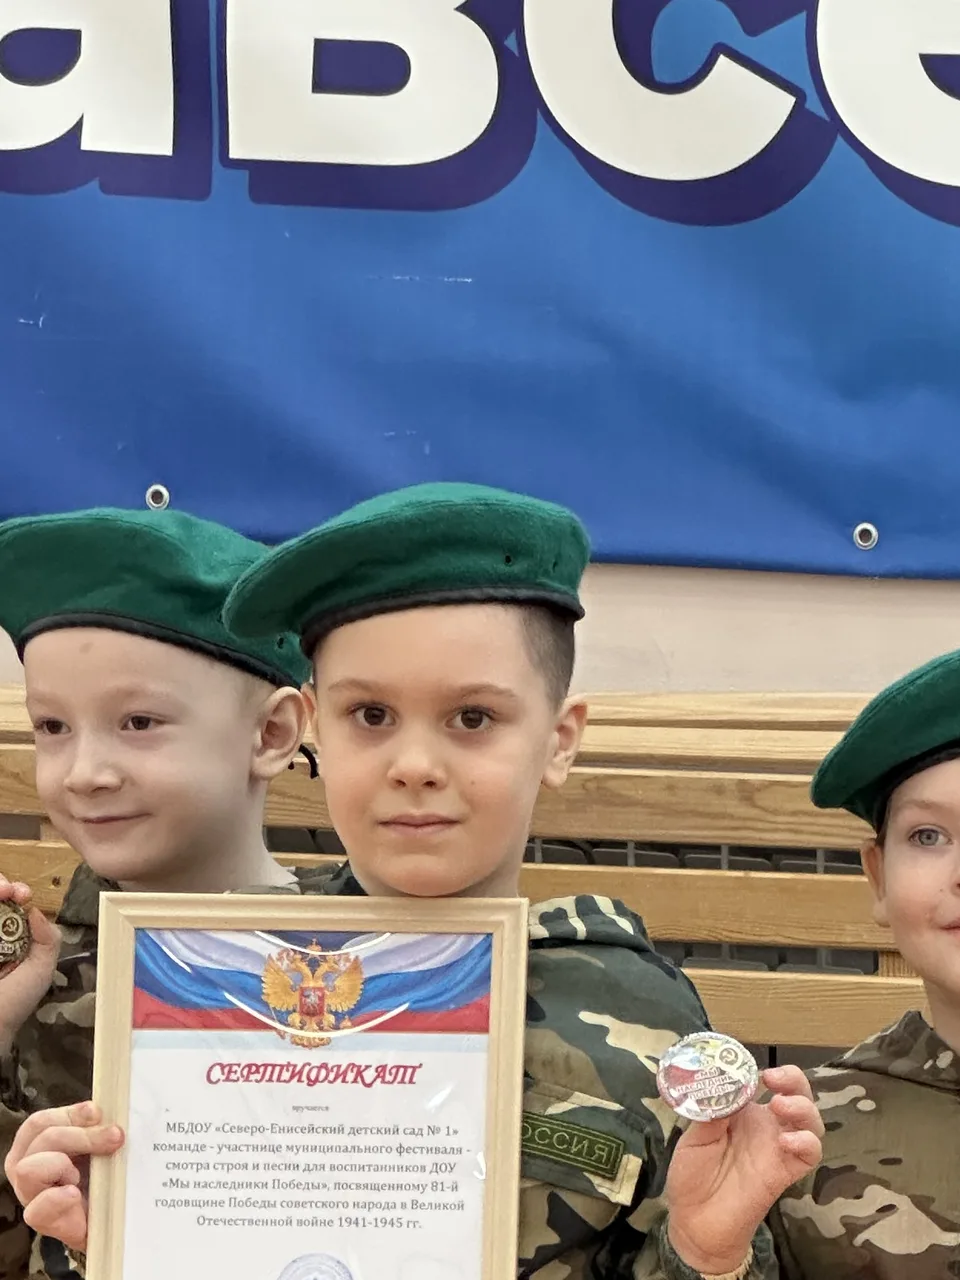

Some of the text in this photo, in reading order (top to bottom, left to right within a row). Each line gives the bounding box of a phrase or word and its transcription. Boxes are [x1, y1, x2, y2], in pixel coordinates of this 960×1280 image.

[206, 1062, 423, 1088] СЕРТИФИКАТ
[166, 1122, 459, 1136] МБДОУ «Северо-Енисейский детский сад № 1»
[153, 1143, 206, 1153] команде
[217, 1143, 282, 1154] участнице
[286, 1144, 392, 1155] муниципального
[396, 1143, 463, 1157] фестиваля
[523, 1123, 608, 1163] ОССИЯ
[165, 1161, 456, 1174] смотра строя и песни для воспитанников ДОУ
[162, 1178, 458, 1194] «Мы наследники Победы», посвященному 81-й
[155, 1197, 464, 1212] годовщине Победы советского народа в Великой
[196, 1215, 422, 1229] Отечественной войне 1941-1945 гг.
